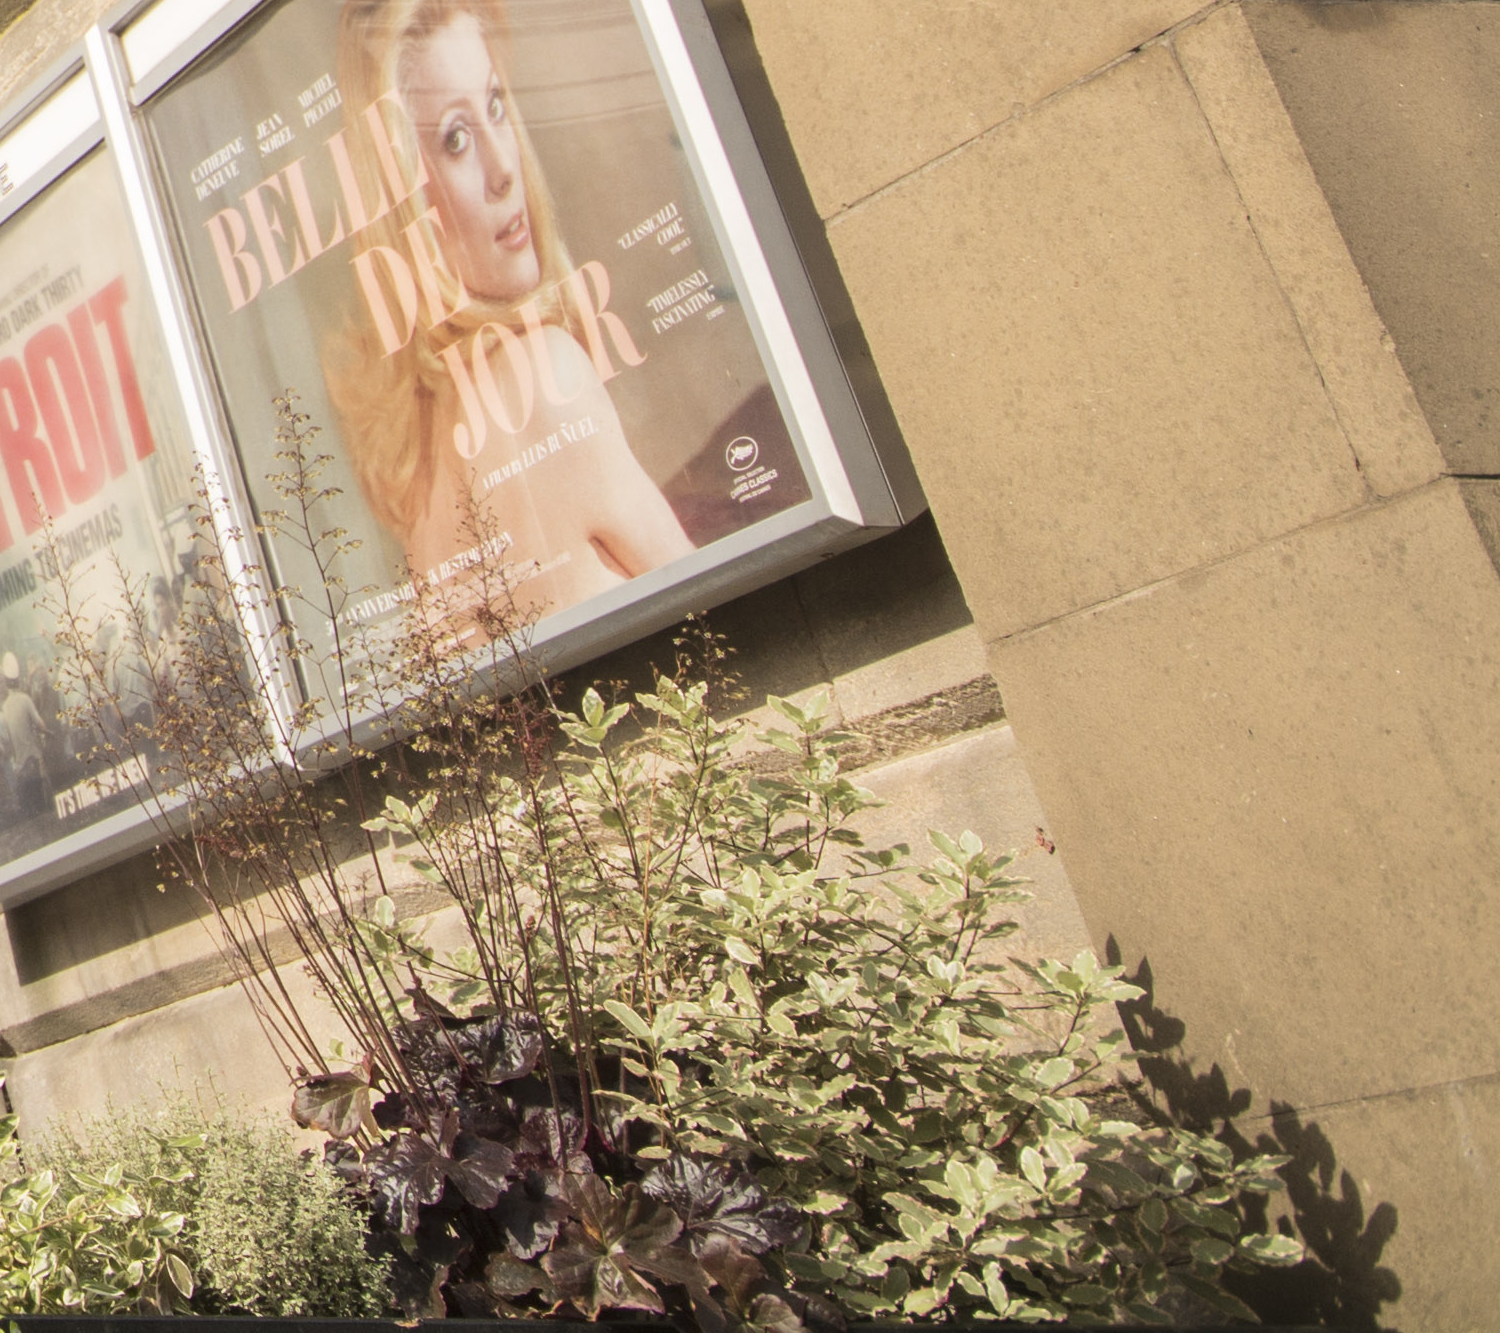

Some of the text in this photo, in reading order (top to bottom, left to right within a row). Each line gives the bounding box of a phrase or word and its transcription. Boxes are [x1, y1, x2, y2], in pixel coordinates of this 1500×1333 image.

[190, 73, 337, 184] CATHERINE JEAN MICHEL
[195, 89, 342, 201] DENEUVE SOREL PICCOLI
[203, 87, 430, 315] BELLE
[40, 263, 85, 310] THIRTY
[349, 206, 470, 360] DE
[433, 260, 648, 460] JOUR
[521, 443, 549, 469] LUIS
[546, 416, 599, 454] BUÑUEL
[57, 504, 124, 574] CINEMAS
